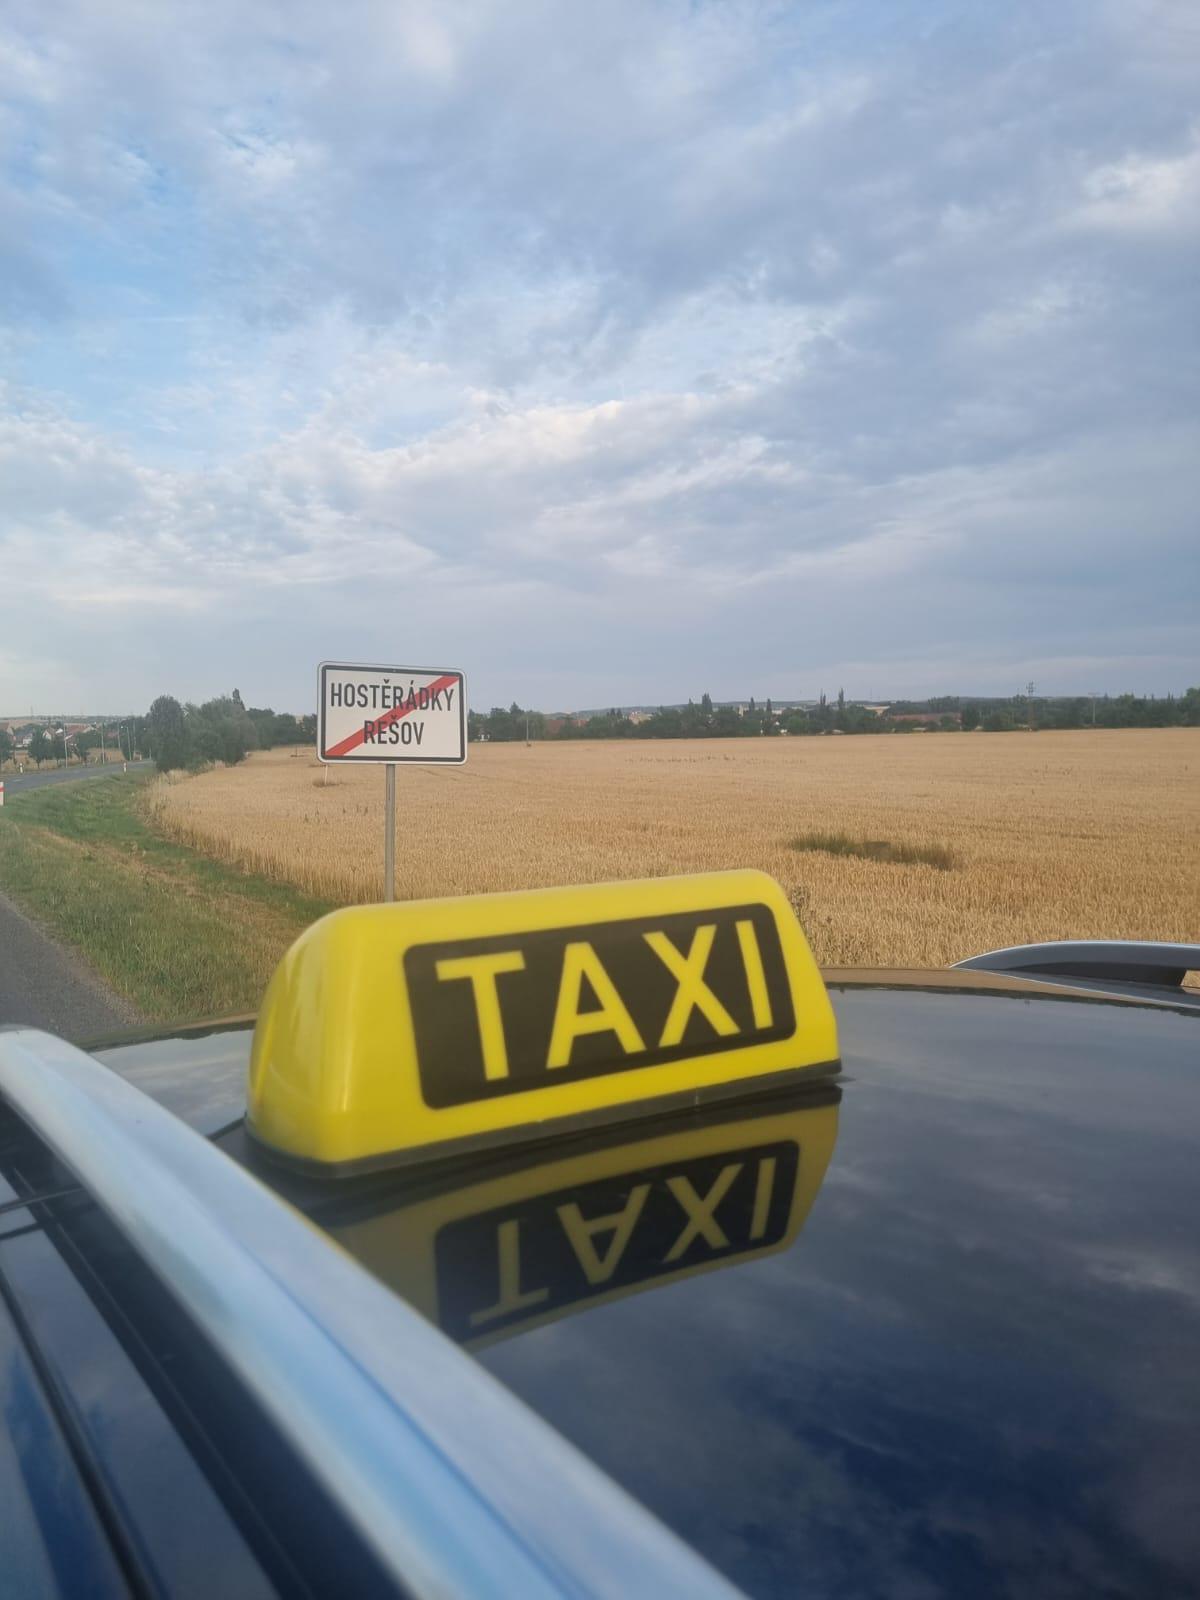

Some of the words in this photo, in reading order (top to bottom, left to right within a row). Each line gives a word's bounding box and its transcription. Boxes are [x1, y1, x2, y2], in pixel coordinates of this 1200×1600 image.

[330, 679, 454, 711] HOSTĚRÁDKY
[363, 715, 424, 745] REŠOV
[435, 920, 774, 1081] TAXI
